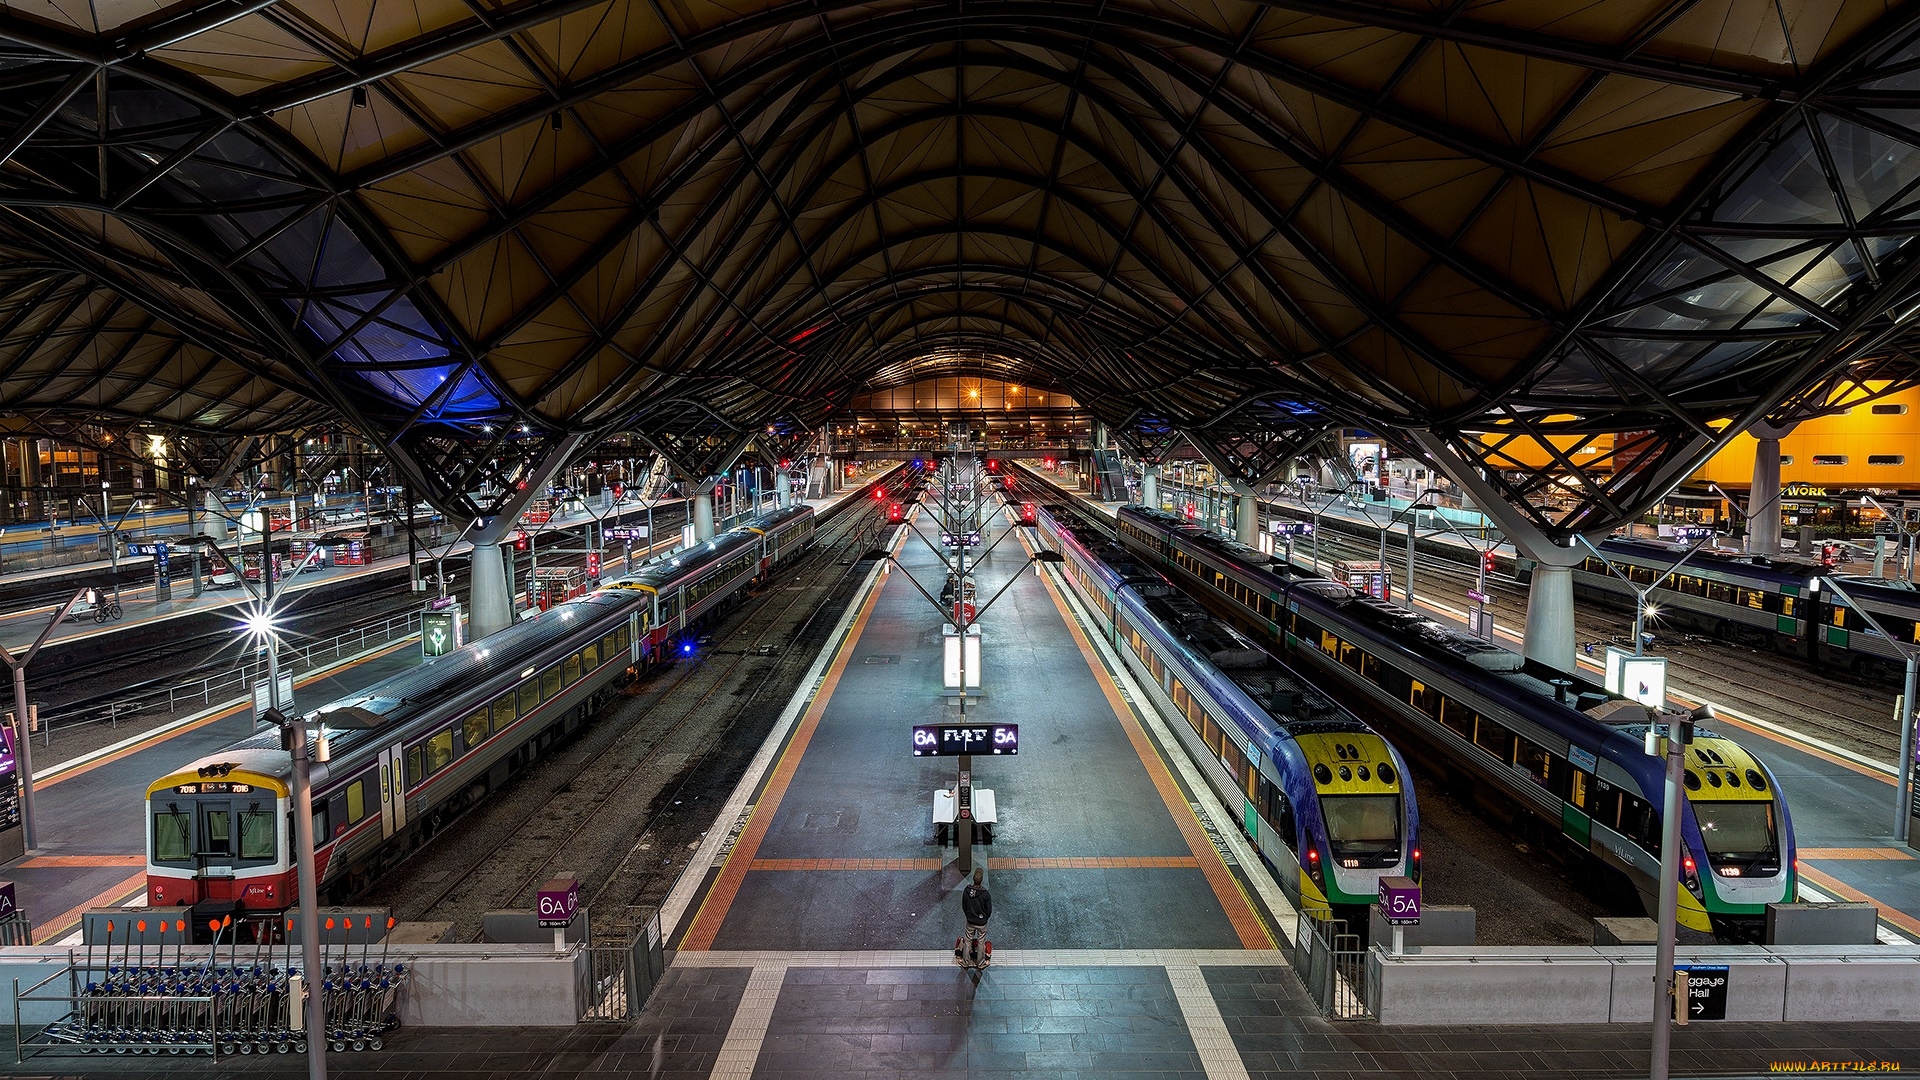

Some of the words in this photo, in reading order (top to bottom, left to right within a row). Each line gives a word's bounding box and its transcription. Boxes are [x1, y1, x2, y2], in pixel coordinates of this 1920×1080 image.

[914, 729, 937, 745] 6A
[994, 728, 1017, 744] 5A
[179, 785, 197, 794] 7016
[231, 784, 249, 793] 7016
[1343, 859, 1359, 868] 1119
[1720, 868, 1740, 876] 1139
[0, 895, 12, 912] A
[540, 896, 565, 915] 6A
[567, 891, 578, 911] 6A
[1379, 885, 1390, 911] 5A
[1393, 895, 1418, 913] 5A
[1687, 977, 1725, 988] ggage
[1689, 988, 1710, 998] Hall
